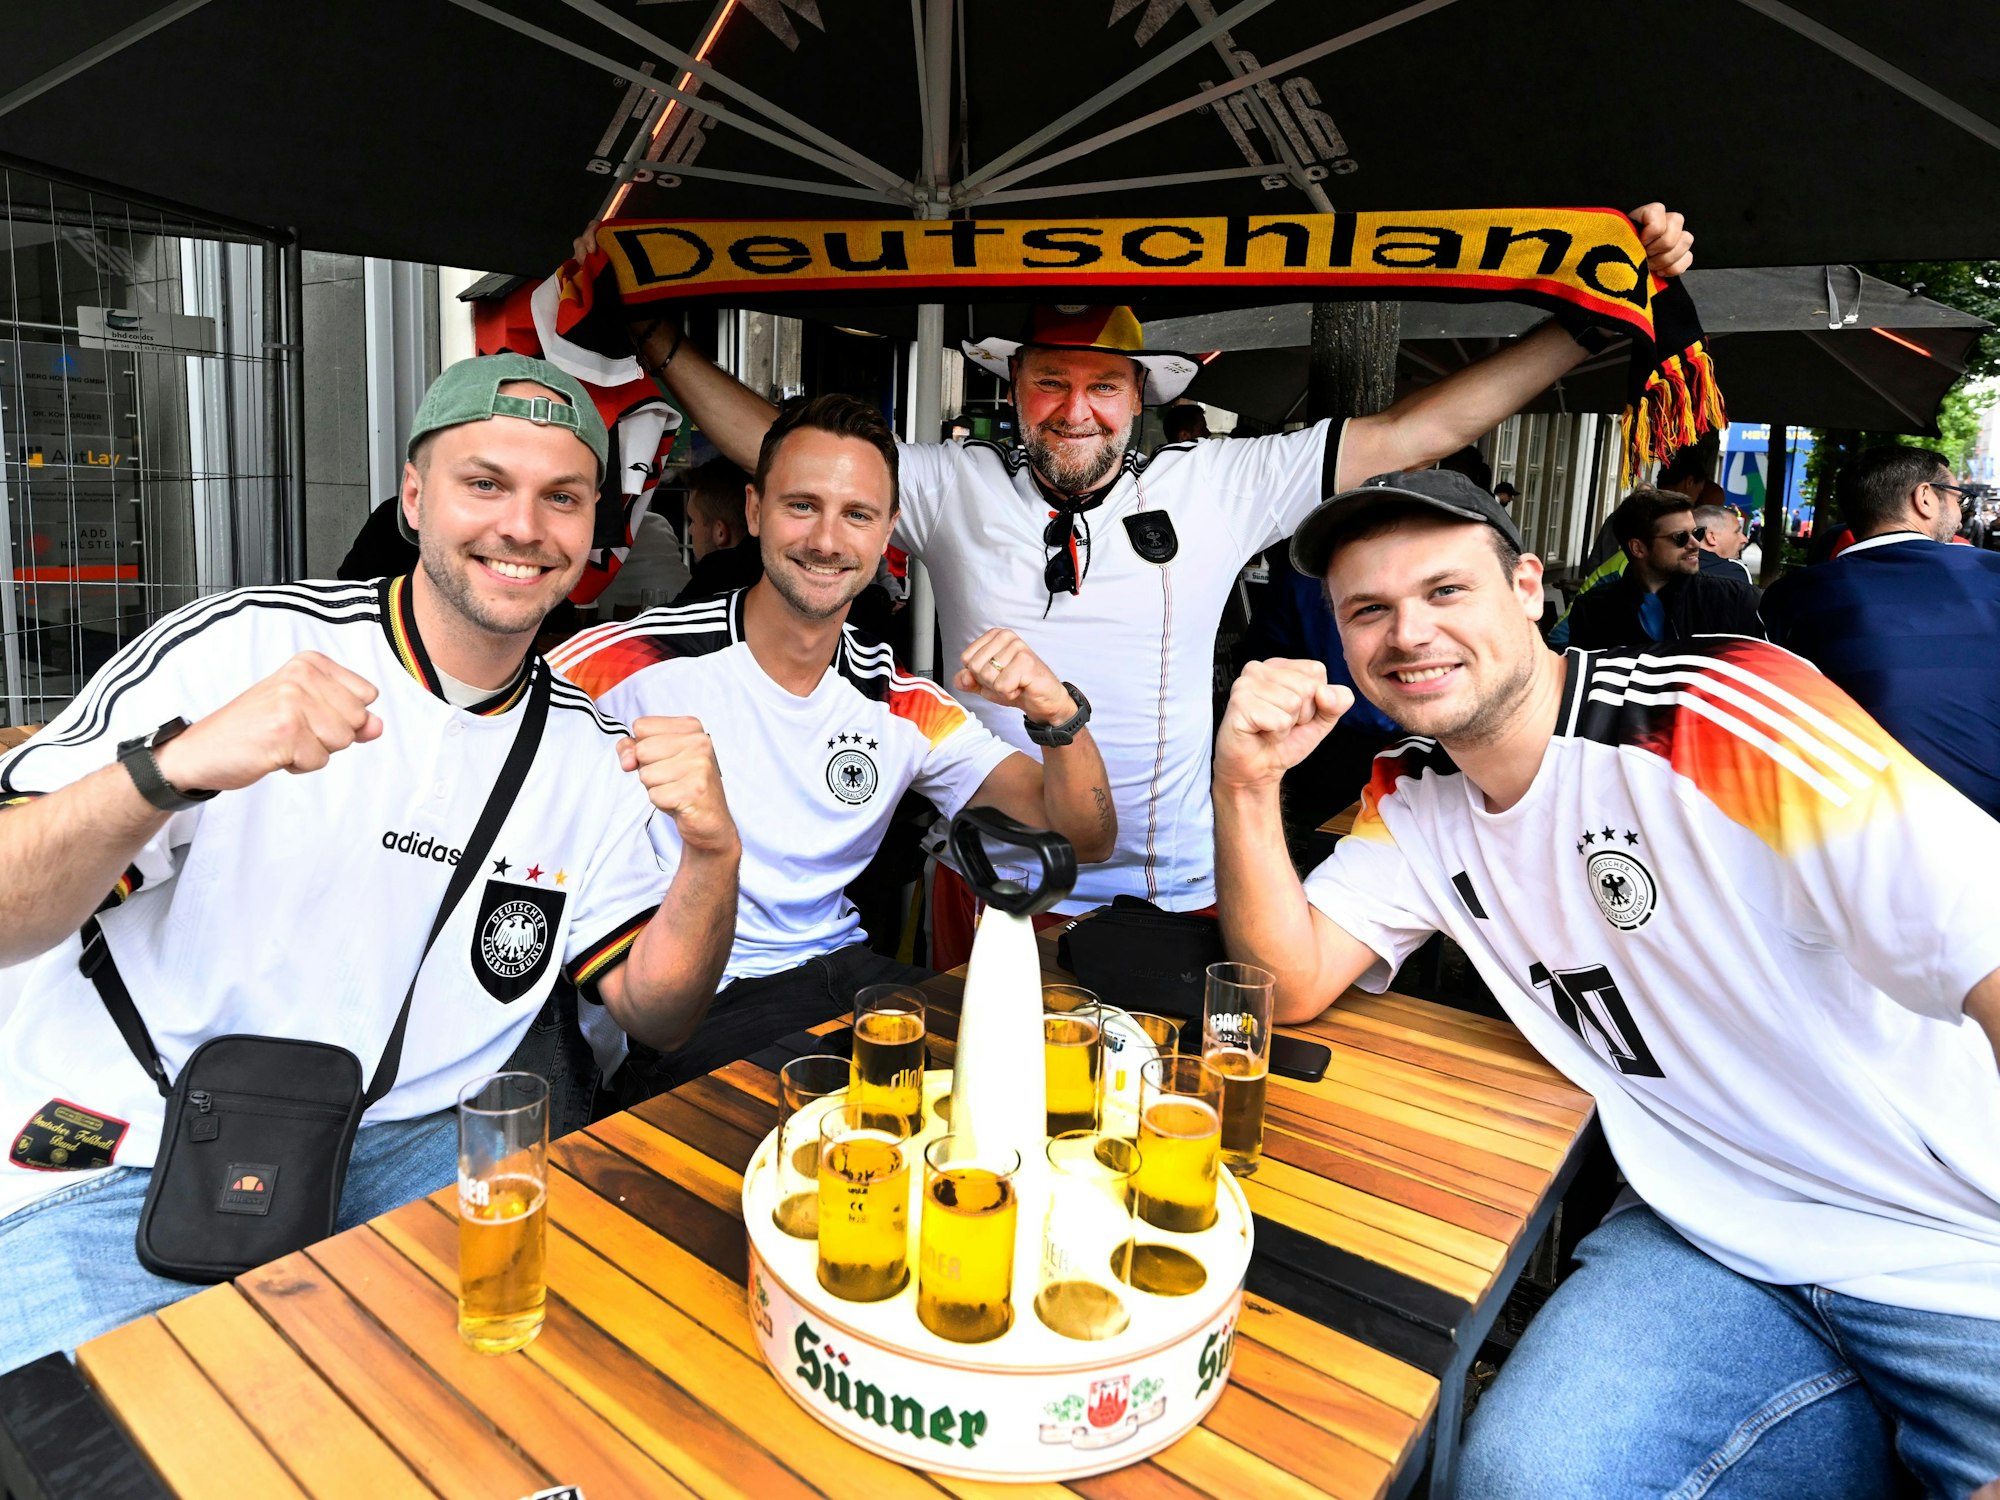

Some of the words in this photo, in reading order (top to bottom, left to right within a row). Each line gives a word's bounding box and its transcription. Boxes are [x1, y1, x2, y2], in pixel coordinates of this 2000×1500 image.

[612, 211, 1649, 310] Deutschland
[26, 373, 47, 381] BERG
[49, 375, 82, 383] HOLING
[1741, 430, 1816, 441] HEUARK
[51, 449, 121, 468] AutLay
[80, 528, 107, 538] ADD
[60, 540, 124, 550] HOLSTEIN
[1252, 572, 1270, 581] Sünn
[382, 830, 463, 867] adidas
[1591, 860, 1630, 878] DEUTSCHER
[491, 902, 545, 930] DEUTSCHER
[484, 936, 544, 975] FUSSBALL-BUND
[32, 1114, 70, 1137] Deutscher
[75, 1129, 115, 1150] Fußball
[49, 1135, 81, 1152] Bund
[794, 1321, 987, 1449] Sünner
